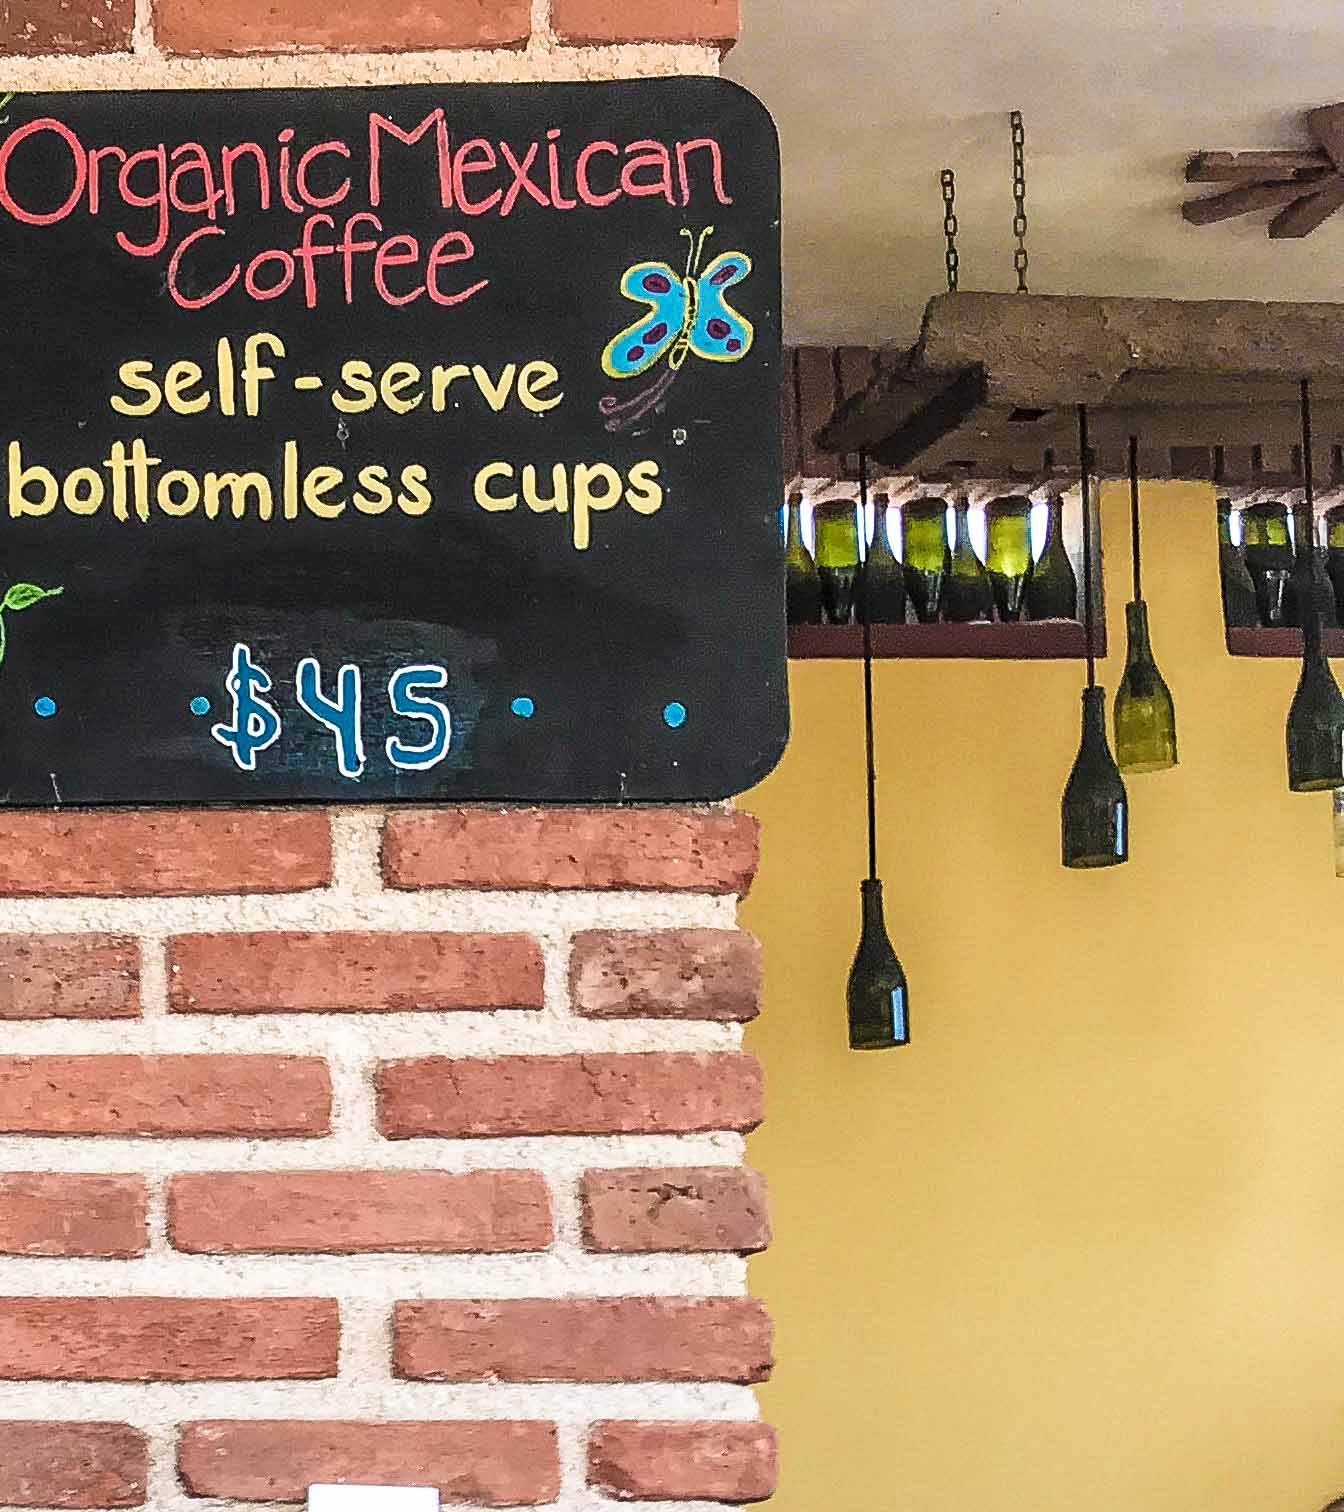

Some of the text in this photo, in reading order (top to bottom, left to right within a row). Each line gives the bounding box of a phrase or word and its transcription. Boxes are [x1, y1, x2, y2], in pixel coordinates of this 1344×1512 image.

[369, 108, 733, 216] Mexican
[167, 212, 491, 311] Coffee
[109, 331, 565, 418] self-serve
[6, 440, 665, 550] bottomless cups
[212, 642, 453, 778] $45
